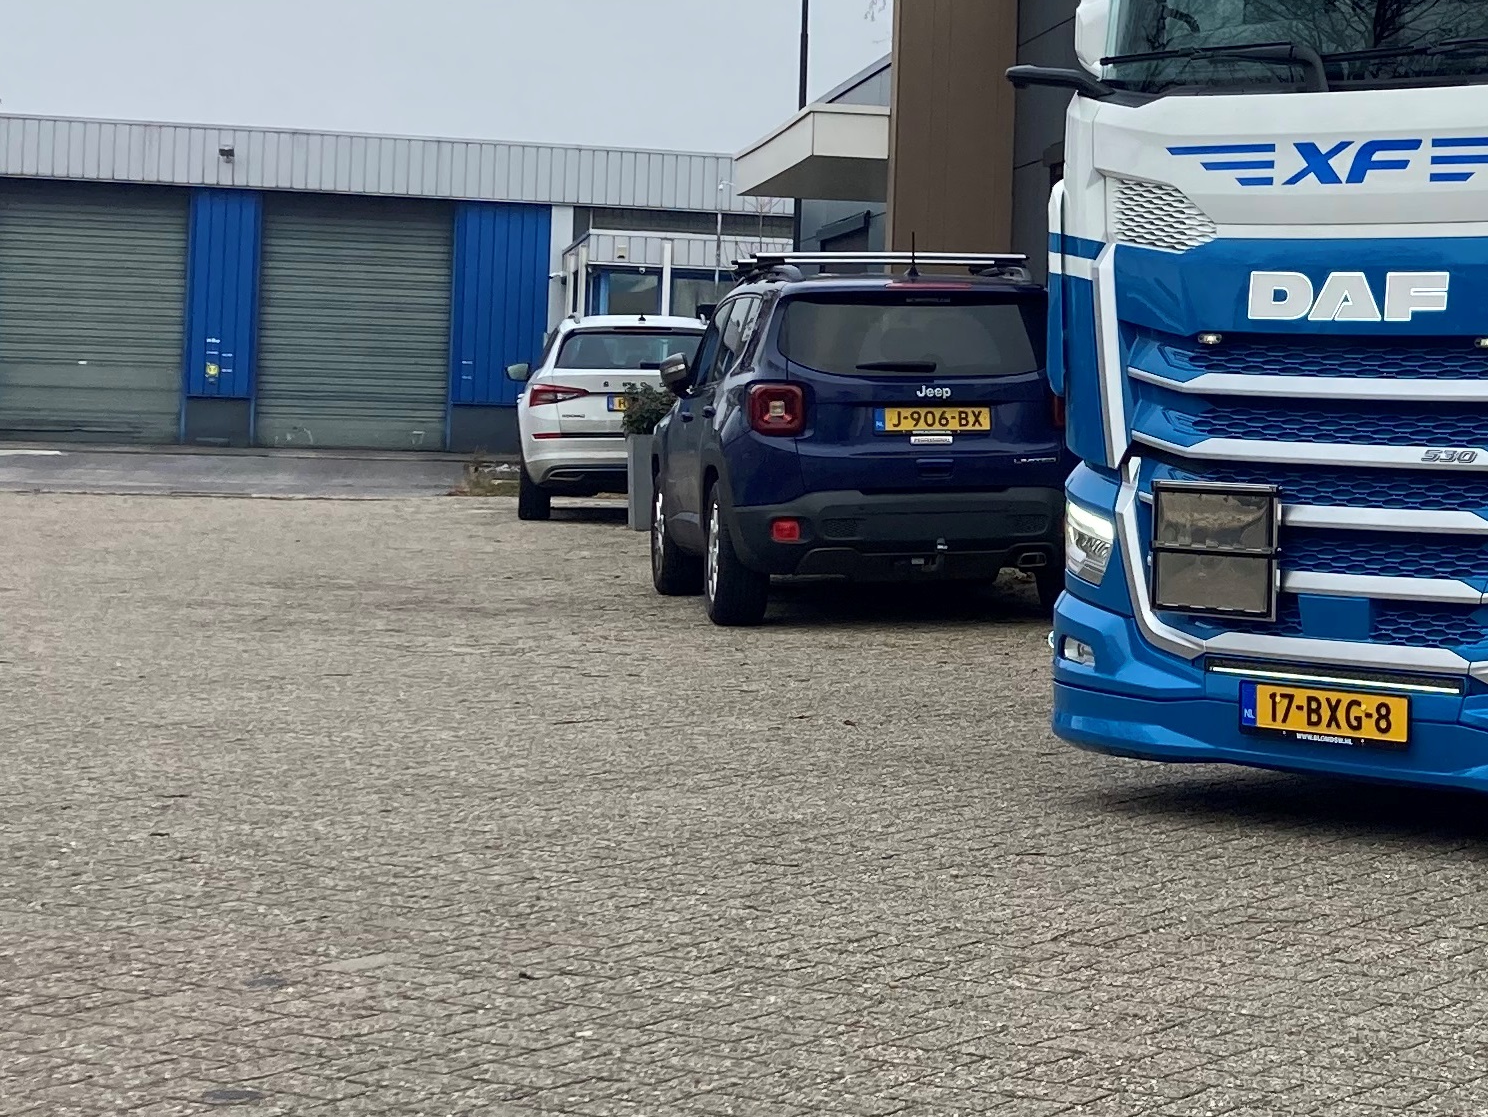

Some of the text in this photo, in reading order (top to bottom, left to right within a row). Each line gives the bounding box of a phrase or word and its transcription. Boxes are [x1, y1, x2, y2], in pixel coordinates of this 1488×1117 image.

[1281, 139, 1422, 185] XF
[1248, 271, 1450, 322] DAF
[917, 385, 951, 399] Jeep
[892, 410, 983, 428] J-906-BX
[1243, 708, 1256, 719] NL
[1269, 691, 1392, 734] 17-BXG-8
